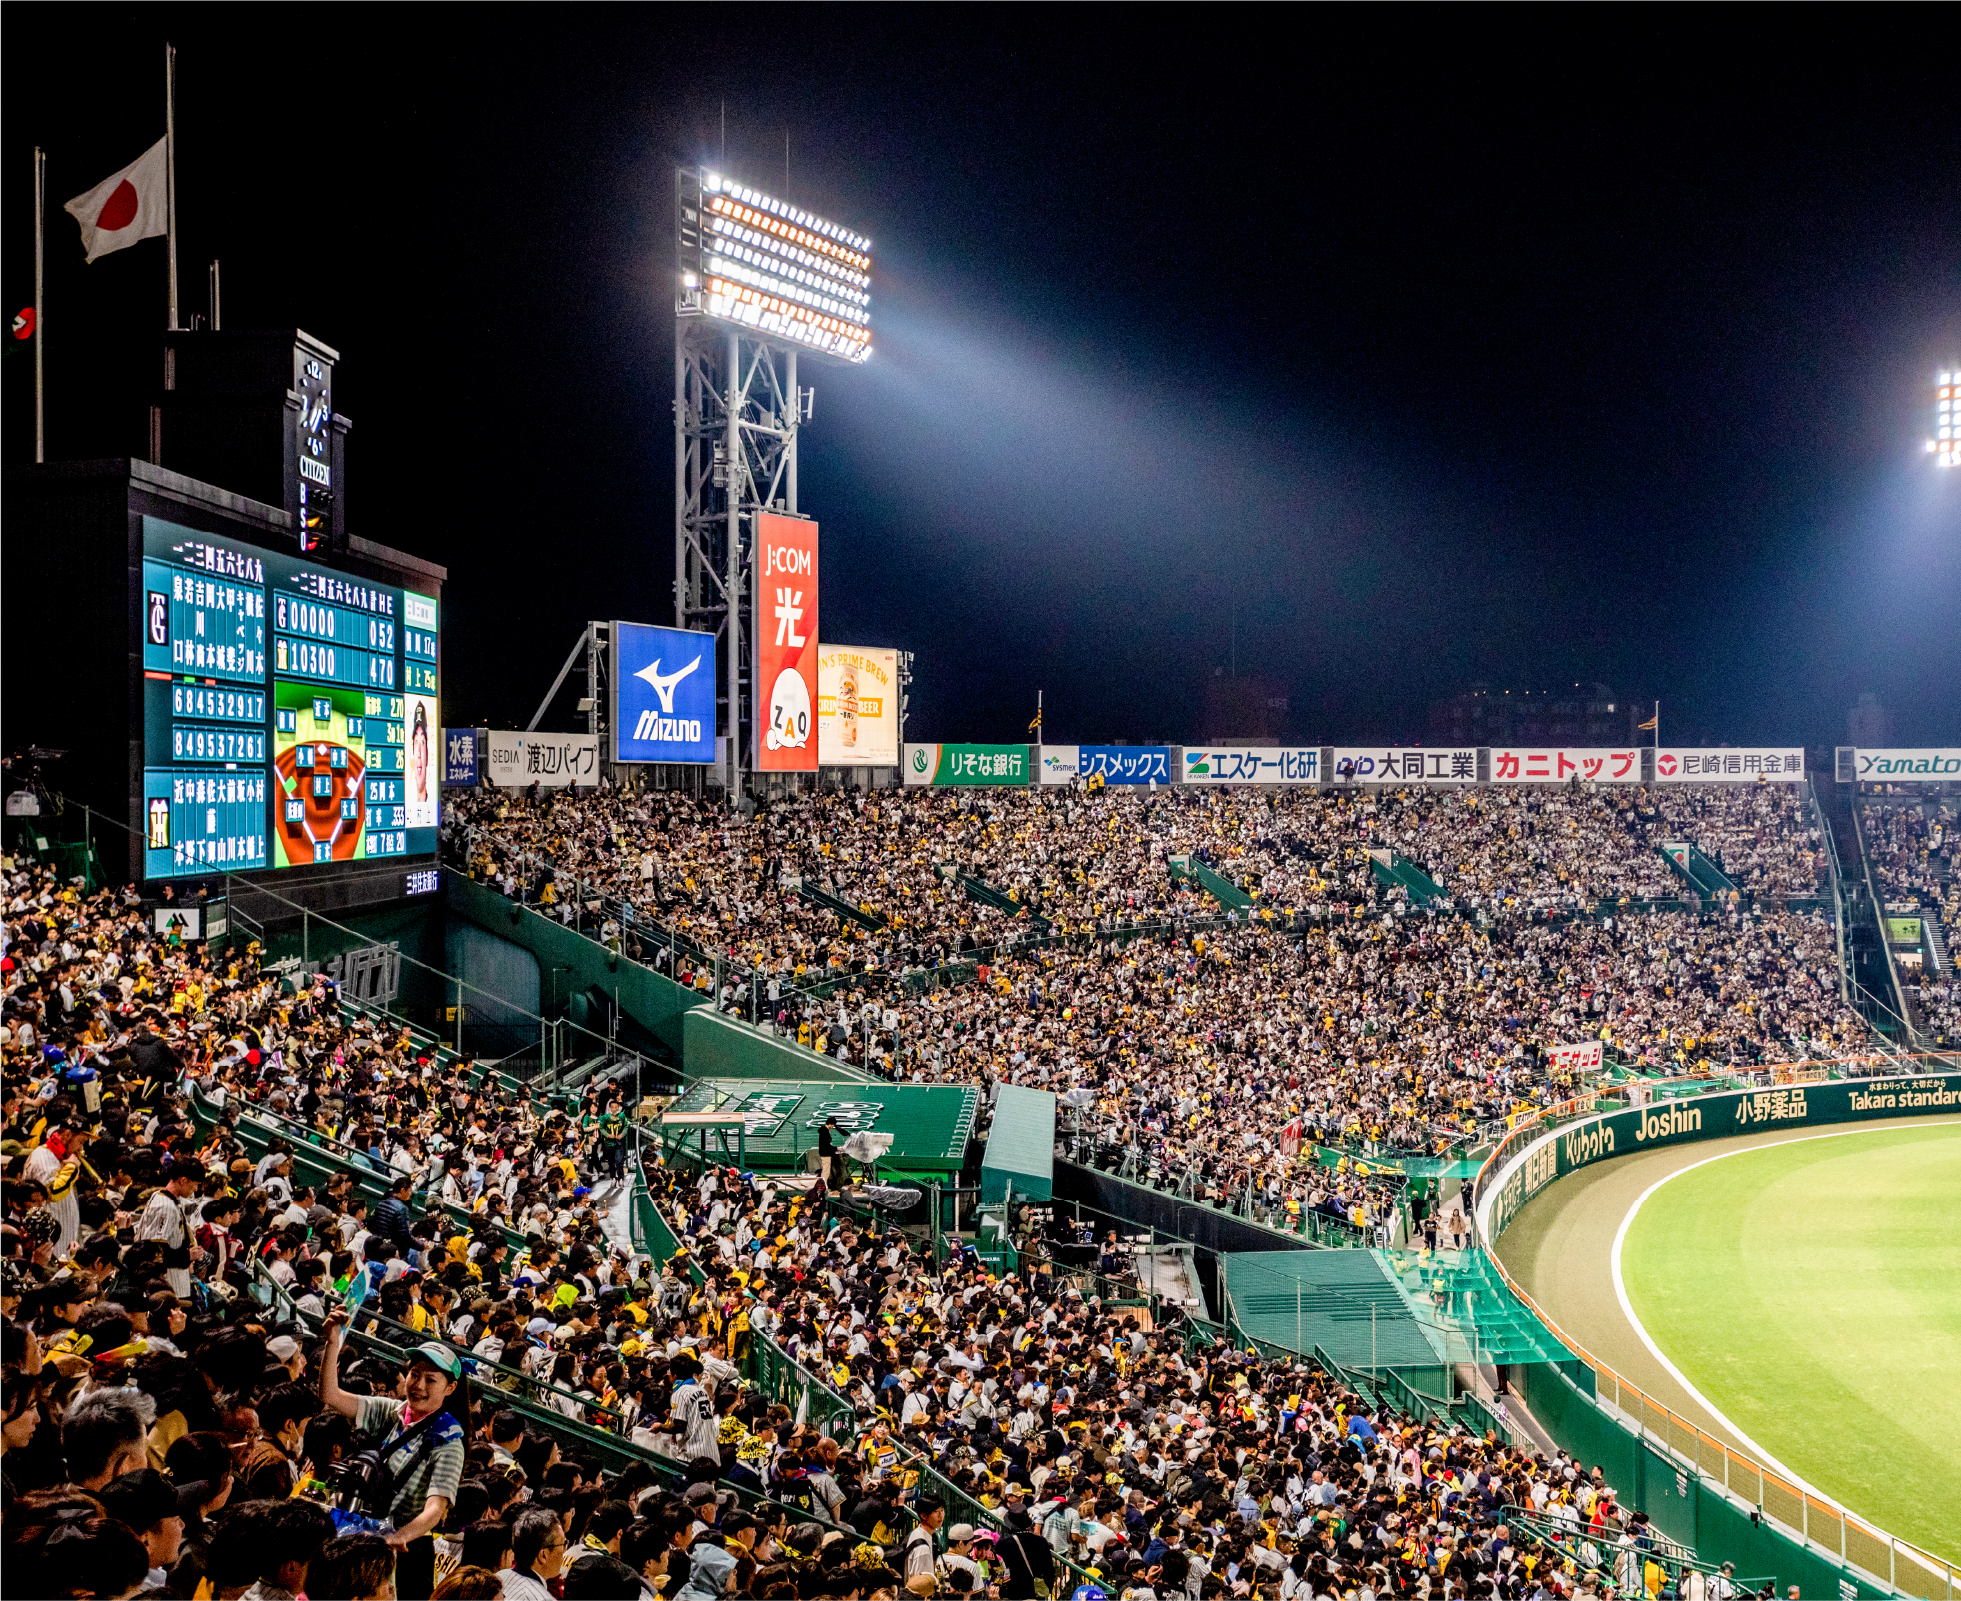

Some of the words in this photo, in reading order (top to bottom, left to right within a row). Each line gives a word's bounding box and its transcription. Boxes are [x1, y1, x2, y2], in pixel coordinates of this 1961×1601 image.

[311, 361, 319, 379] 12
[322, 404, 329, 421] 3
[312, 439, 319, 455] 6
[300, 455, 330, 486] CITIZEN
[300, 483, 307, 503] B
[300, 508, 307, 528] S
[775, 587, 806, 647] 光
[838, 653, 864, 670] PRIME
[866, 661, 889, 686] BREW
[390, 698, 404, 718] 2.70
[858, 700, 879, 714] BEER
[449, 735, 474, 765] 水素
[492, 750, 520, 764] SEDIA
[527, 743, 598, 775] 渡辺パイプ
[449, 768, 474, 780] エネルギー
[951, 753, 1022, 776] りそな銀行
[1081, 753, 1167, 777] シスメックス
[1211, 751, 1317, 779] エスケー化研
[1378, 752, 1474, 779] 大同工業
[1496, 752, 1635, 779] カニトップ
[1682, 754, 1802, 774] 尼崎信用金庫
[1735, 1089, 1808, 1125] 小野薬品
[1848, 1091, 1896, 1111] Takara
[1635, 1102, 1702, 1142] Joshin
[1566, 1119, 1615, 1166] Kubota
[1525, 1139, 1557, 1195] 朝日新聞
[665, 1295, 683, 1310] 44
